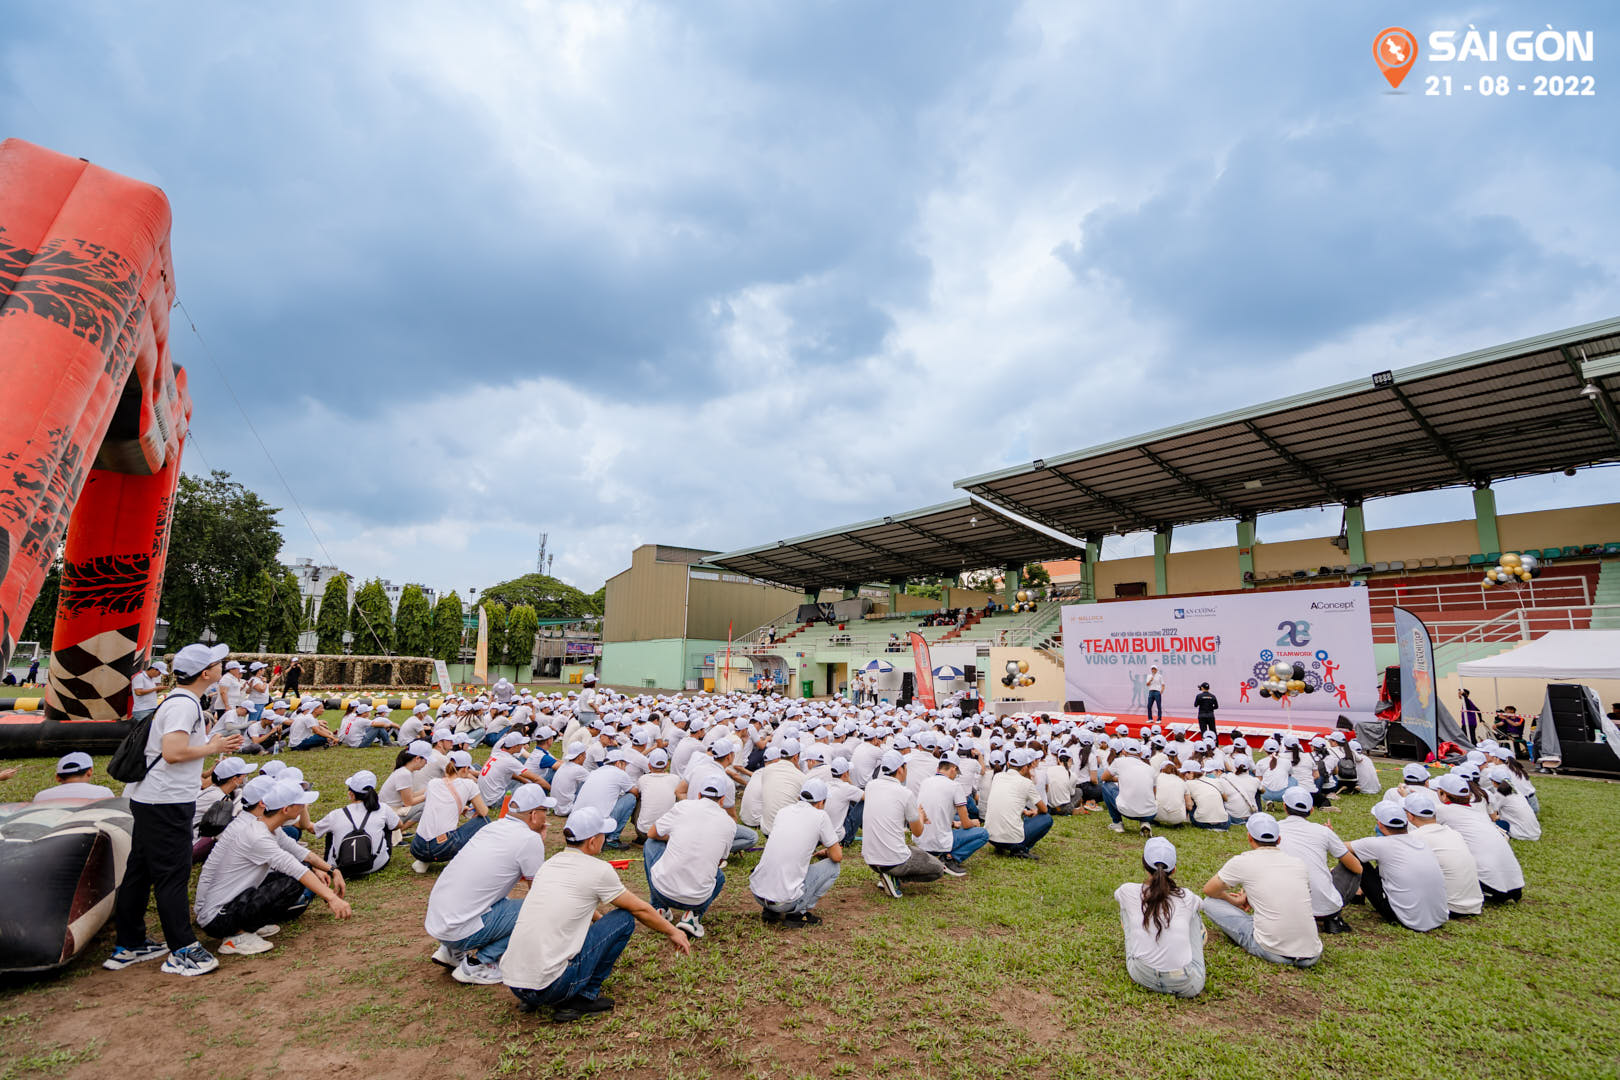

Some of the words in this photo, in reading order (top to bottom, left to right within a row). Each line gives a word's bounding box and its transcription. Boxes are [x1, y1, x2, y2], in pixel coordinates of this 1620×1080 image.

[1310, 601, 1354, 610] AConcept
[1161, 628, 1178, 636] 2022
[1083, 638, 1129, 653] TEAM
[1132, 636, 1216, 653] BUILDING
[1191, 651, 1217, 665] CHÍ
